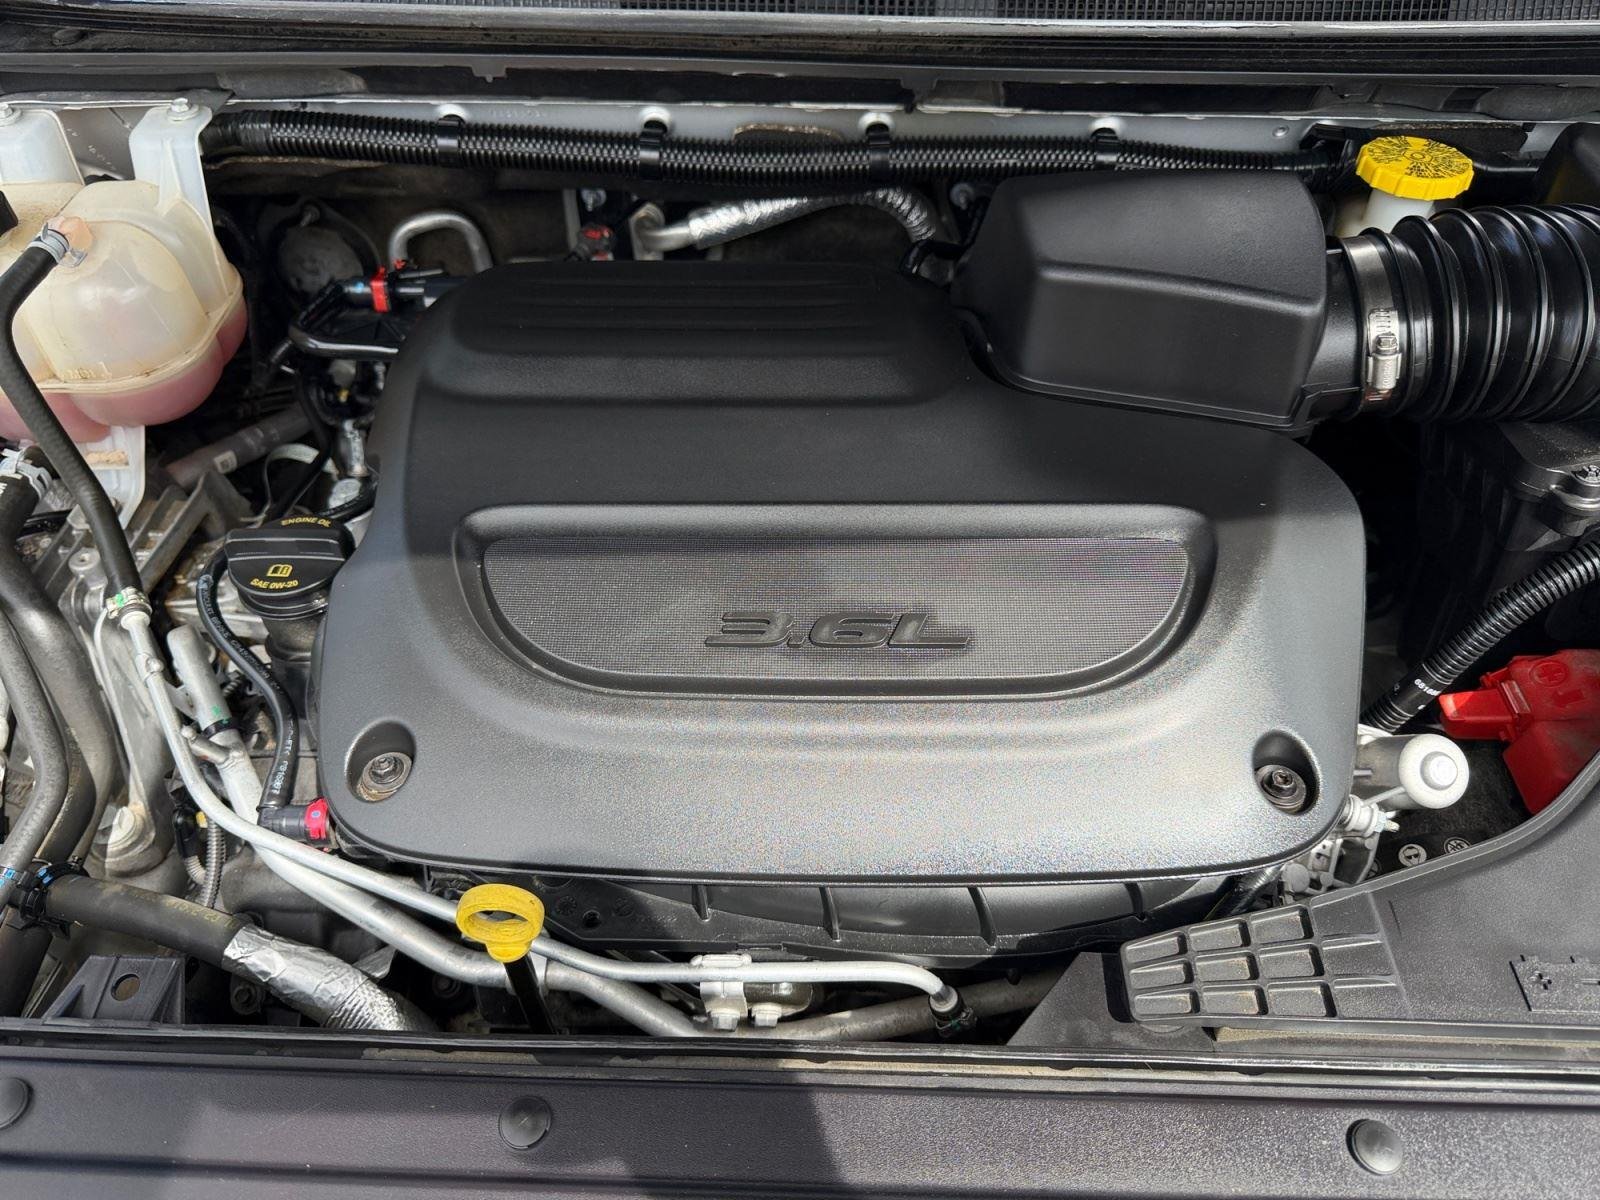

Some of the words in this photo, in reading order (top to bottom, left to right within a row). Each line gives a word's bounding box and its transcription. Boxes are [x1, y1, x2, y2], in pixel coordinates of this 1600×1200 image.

[281, 516, 317, 526] ENGINE
[250, 578, 269, 589] SAE
[269, 579, 299, 589] 0W-20
[704, 611, 970, 648] 3.6L
